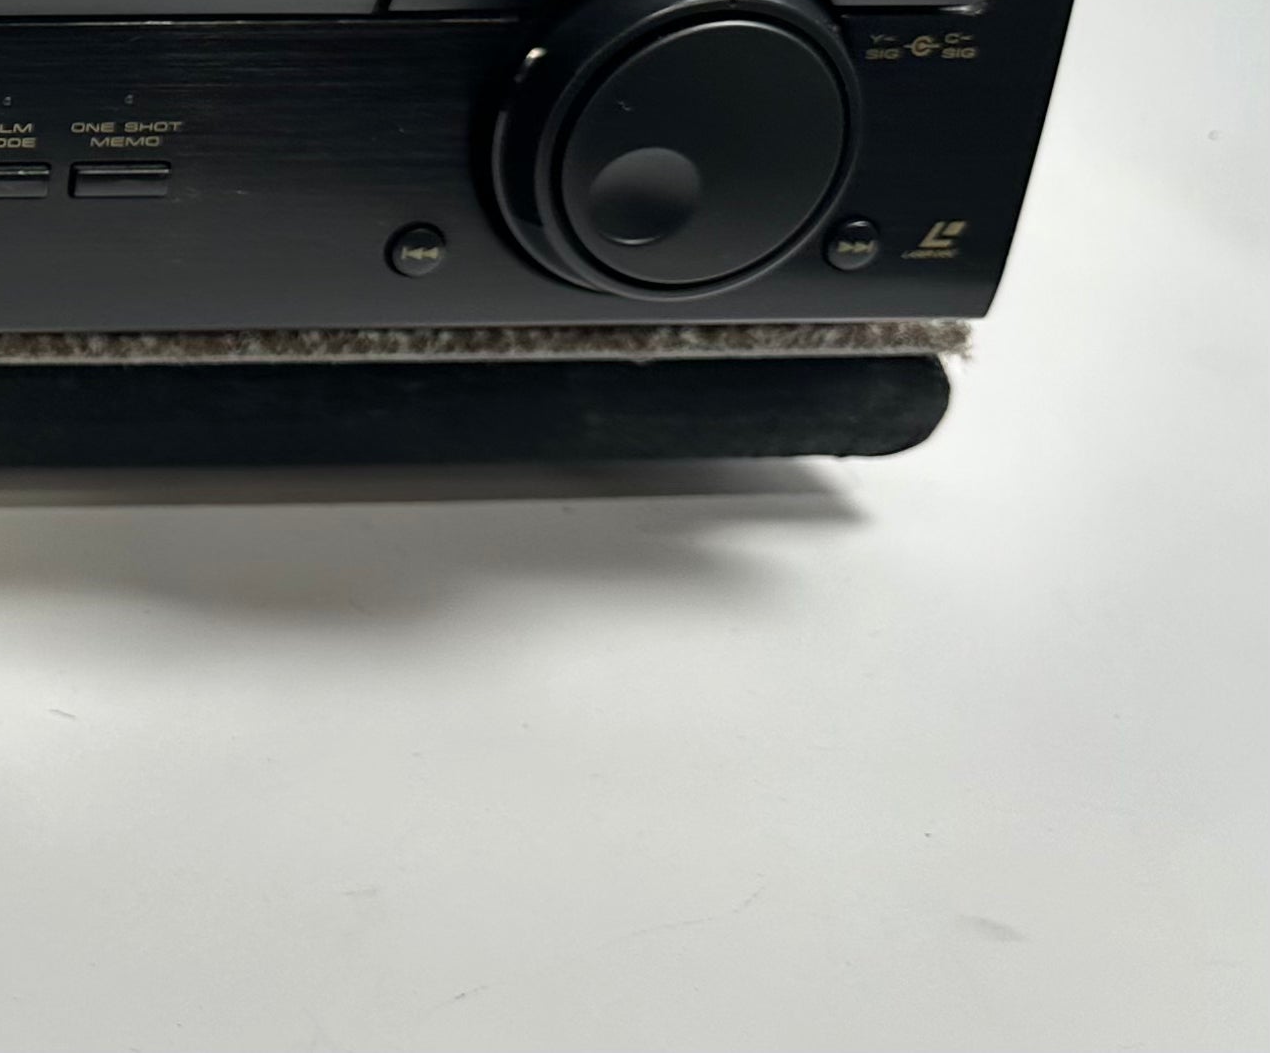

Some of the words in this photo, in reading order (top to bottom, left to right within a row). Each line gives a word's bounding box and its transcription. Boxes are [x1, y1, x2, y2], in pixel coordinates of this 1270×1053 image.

[865, 49, 900, 60] SIG
[940, 48, 977, 59] SIG
[70, 122, 115, 134] ONE
[124, 121, 183, 133] SHOT
[90, 136, 162, 148] MEMO
